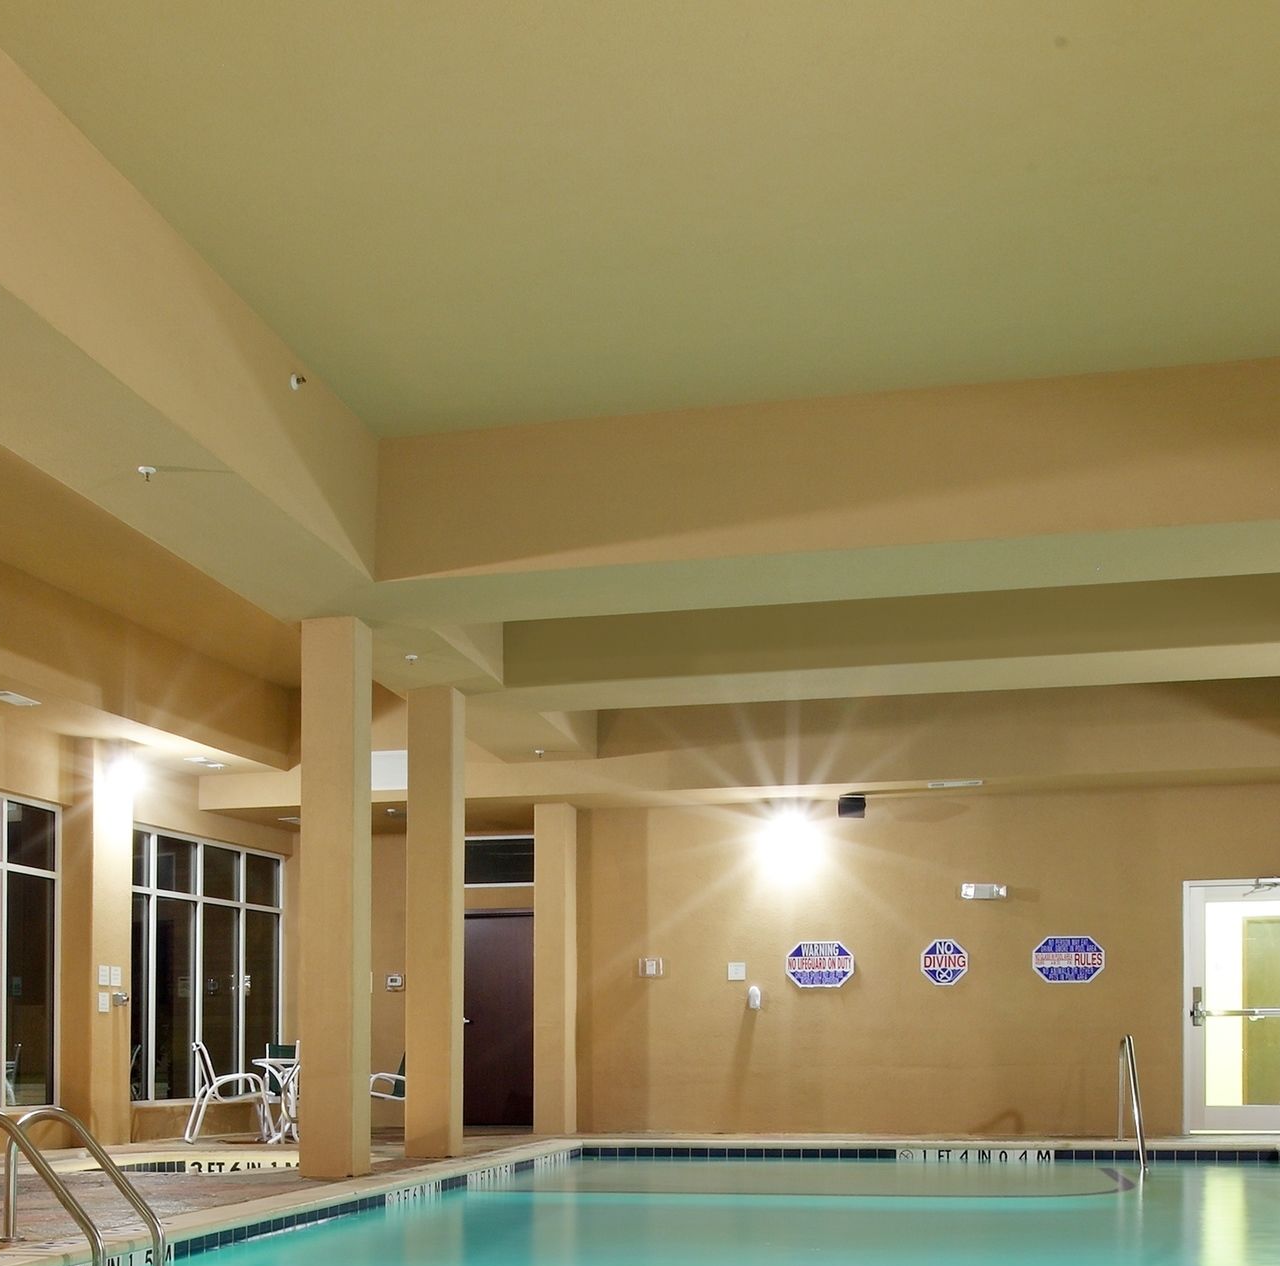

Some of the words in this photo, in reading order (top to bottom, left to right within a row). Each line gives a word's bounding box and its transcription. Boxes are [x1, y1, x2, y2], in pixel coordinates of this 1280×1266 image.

[801, 943, 839, 956] WARNING
[936, 941, 954, 954] NO
[788, 957, 797, 970] NO
[797, 957, 826, 970] LIFEGUARD
[828, 957, 836, 970] ON
[837, 957, 851, 970] DUTY
[924, 955, 966, 968] DIVING
[1074, 953, 1103, 966] RULES
[938, 1150, 952, 1160] FT
[978, 1150, 991, 1161] IN
[1037, 1150, 1051, 1161] M
[207, 1161, 225, 1173] FT
